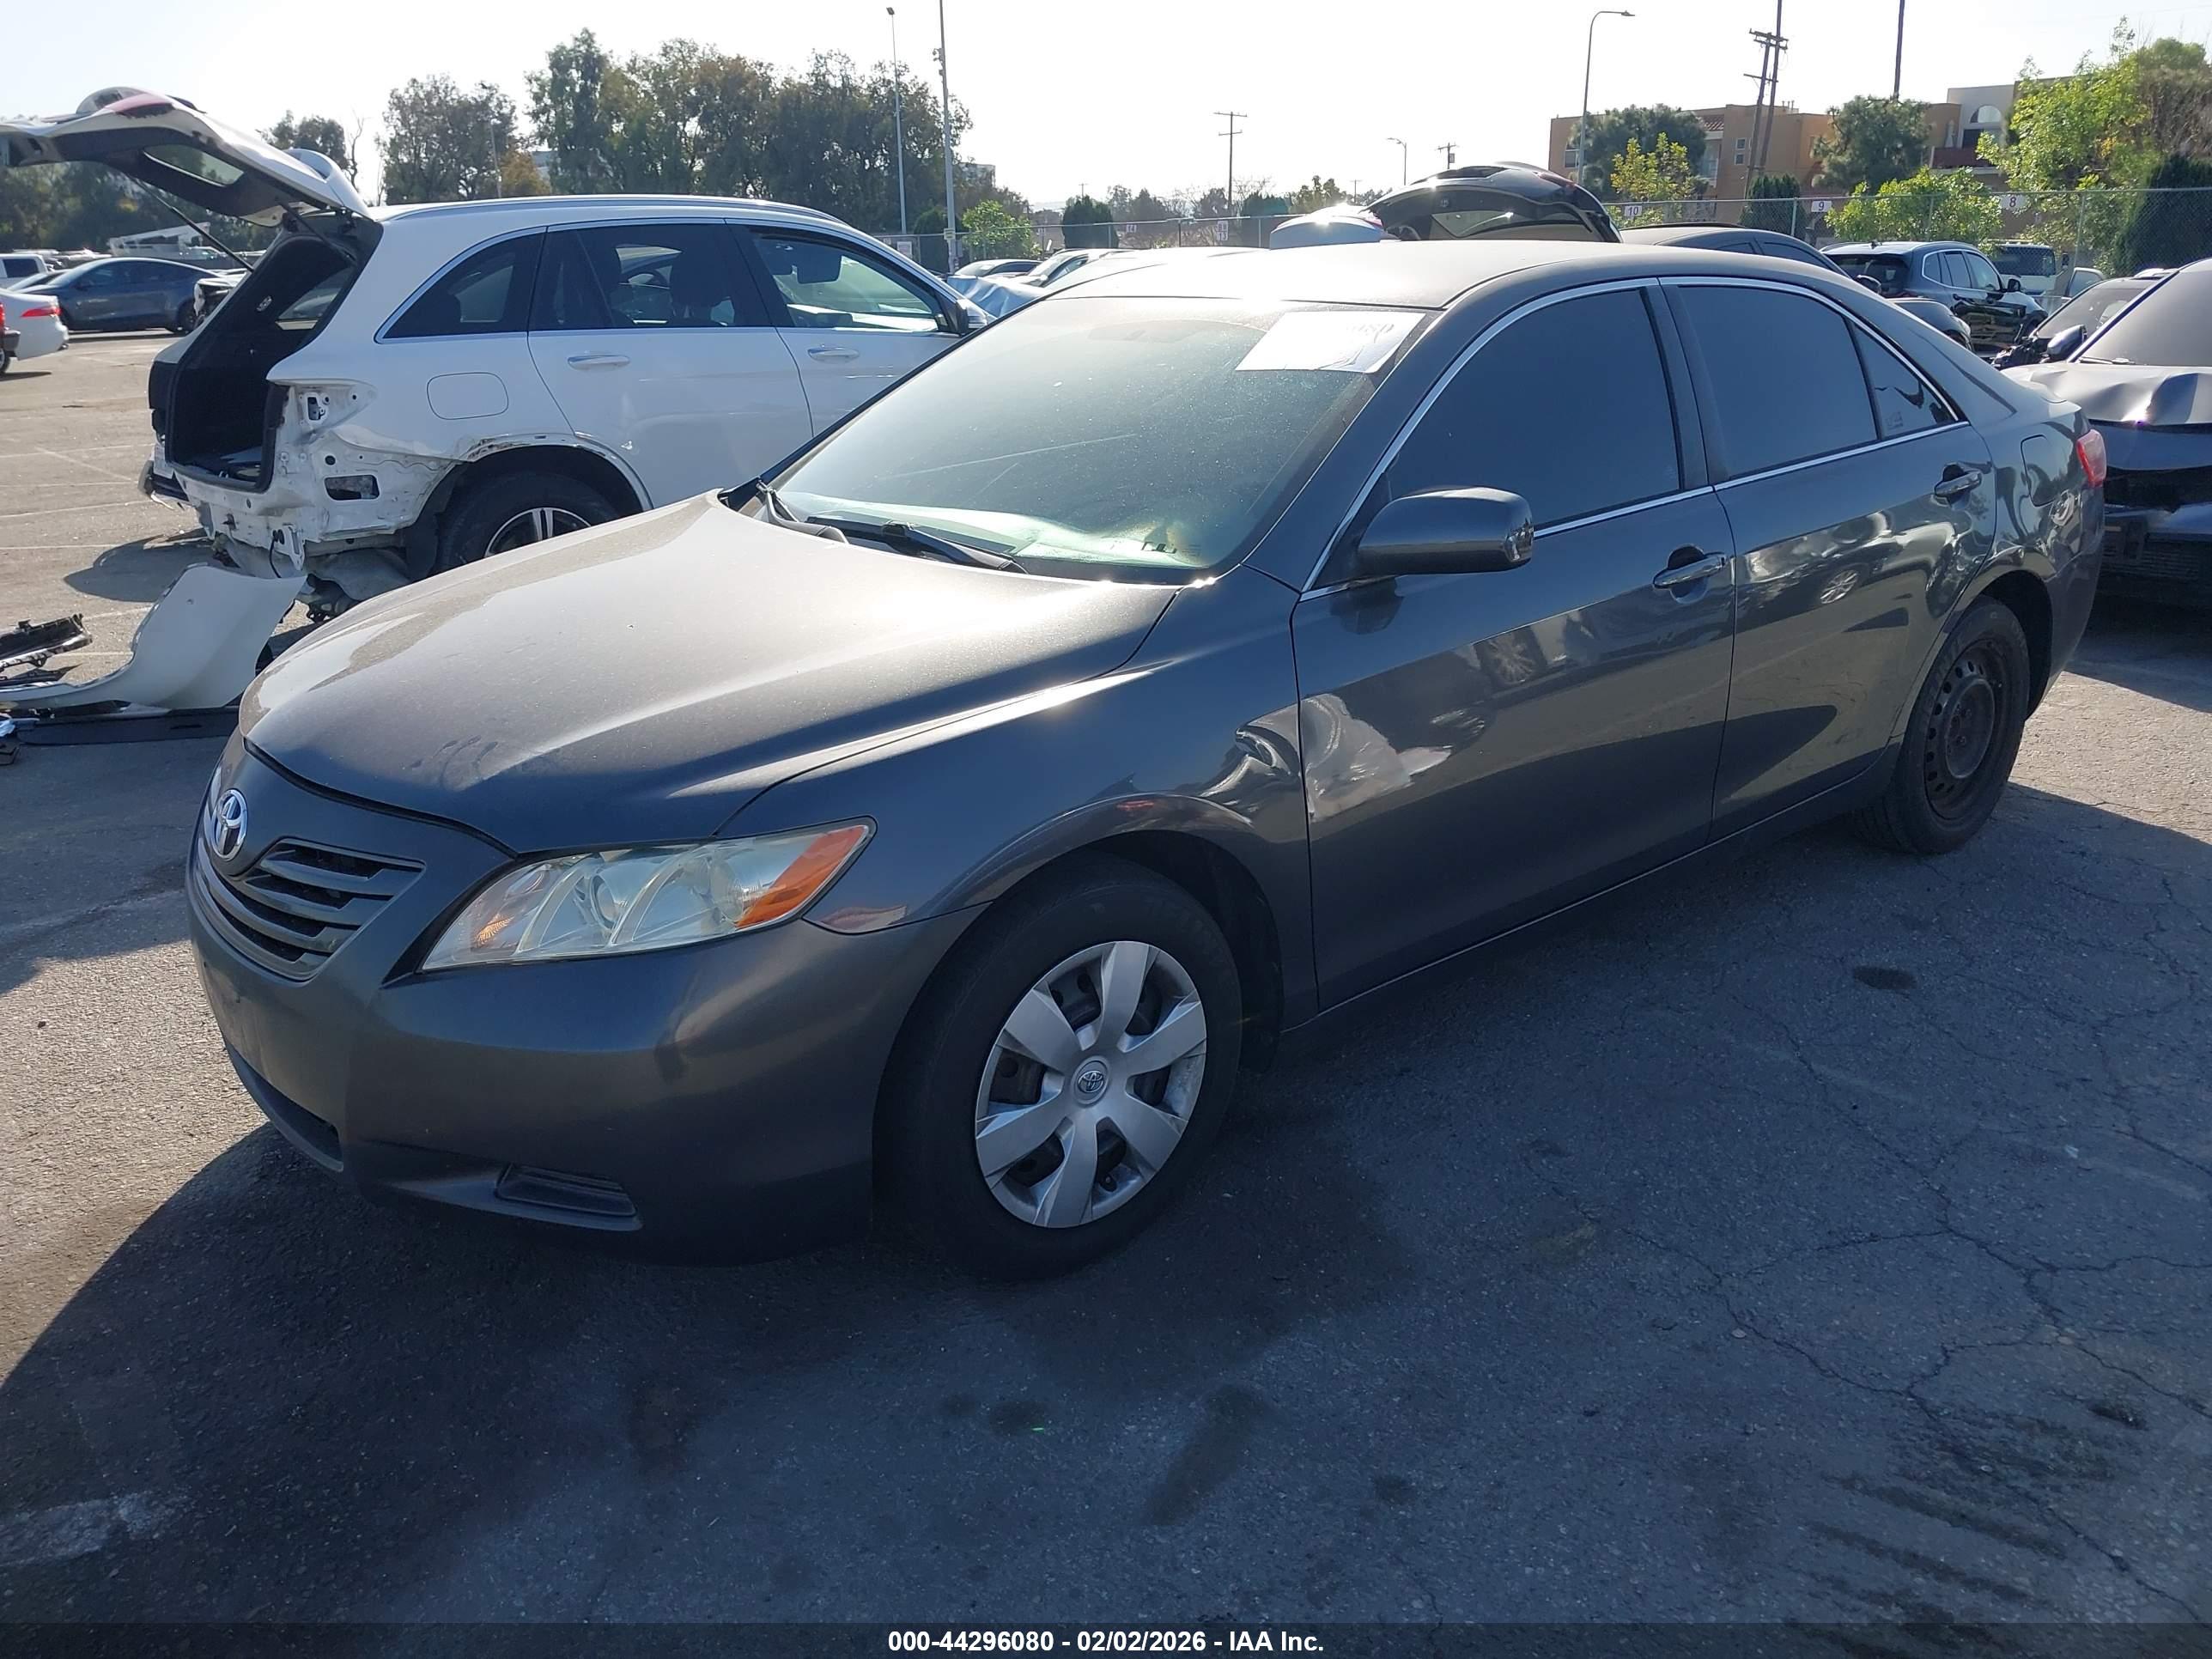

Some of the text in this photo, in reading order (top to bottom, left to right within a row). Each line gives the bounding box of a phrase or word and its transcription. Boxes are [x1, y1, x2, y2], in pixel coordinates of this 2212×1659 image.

[1818, 201, 1825, 211] 9
[2009, 197, 2017, 207] 8
[1628, 206, 1639, 216] 10
